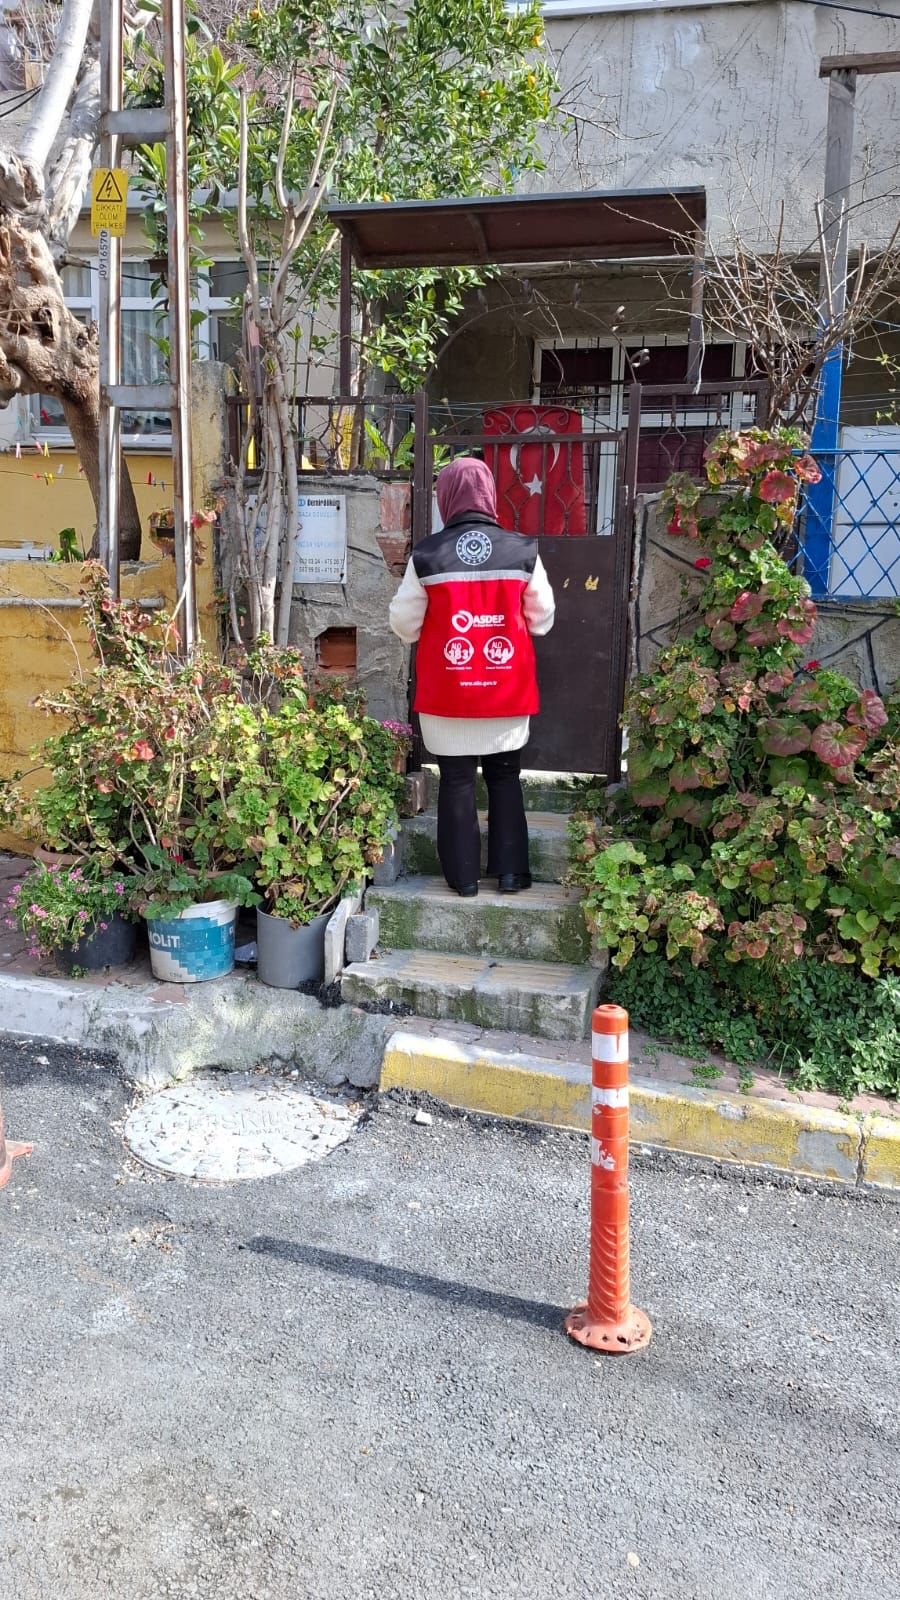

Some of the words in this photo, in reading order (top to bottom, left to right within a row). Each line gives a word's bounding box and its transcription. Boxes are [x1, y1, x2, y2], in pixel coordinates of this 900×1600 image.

[99, 230, 108, 276] 0916570
[473, 614, 504, 624] ASDEP
[451, 642, 462, 650] ALO
[491, 641, 503, 649] ALO
[489, 648, 509, 659] 144
